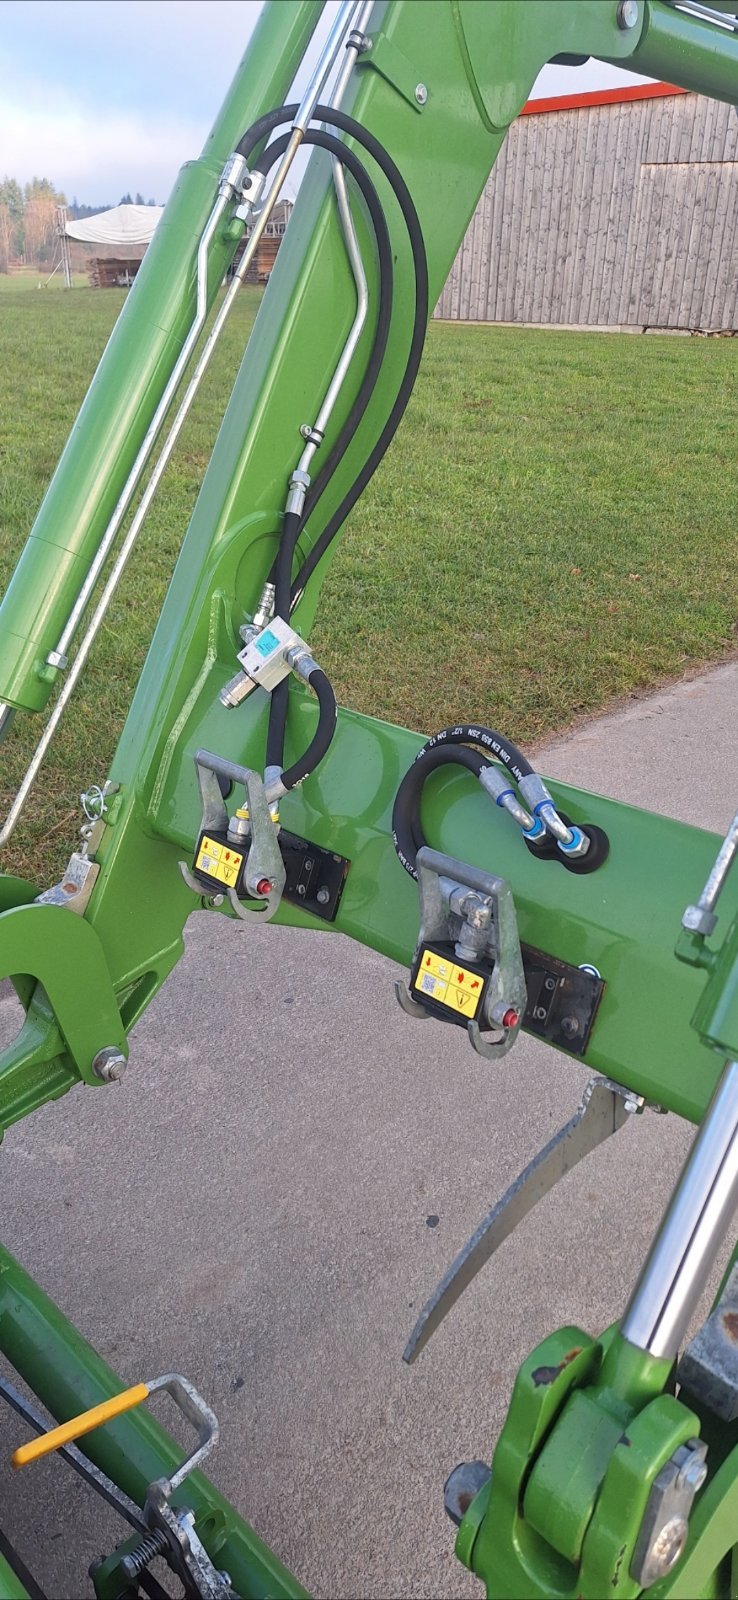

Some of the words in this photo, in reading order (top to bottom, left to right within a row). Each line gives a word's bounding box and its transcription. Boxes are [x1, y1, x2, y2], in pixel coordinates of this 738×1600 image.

[437, 731, 447, 741] DN
[429, 737, 436, 747] 12
[491, 741, 501, 752] EN
[499, 749, 511, 763] DIN
